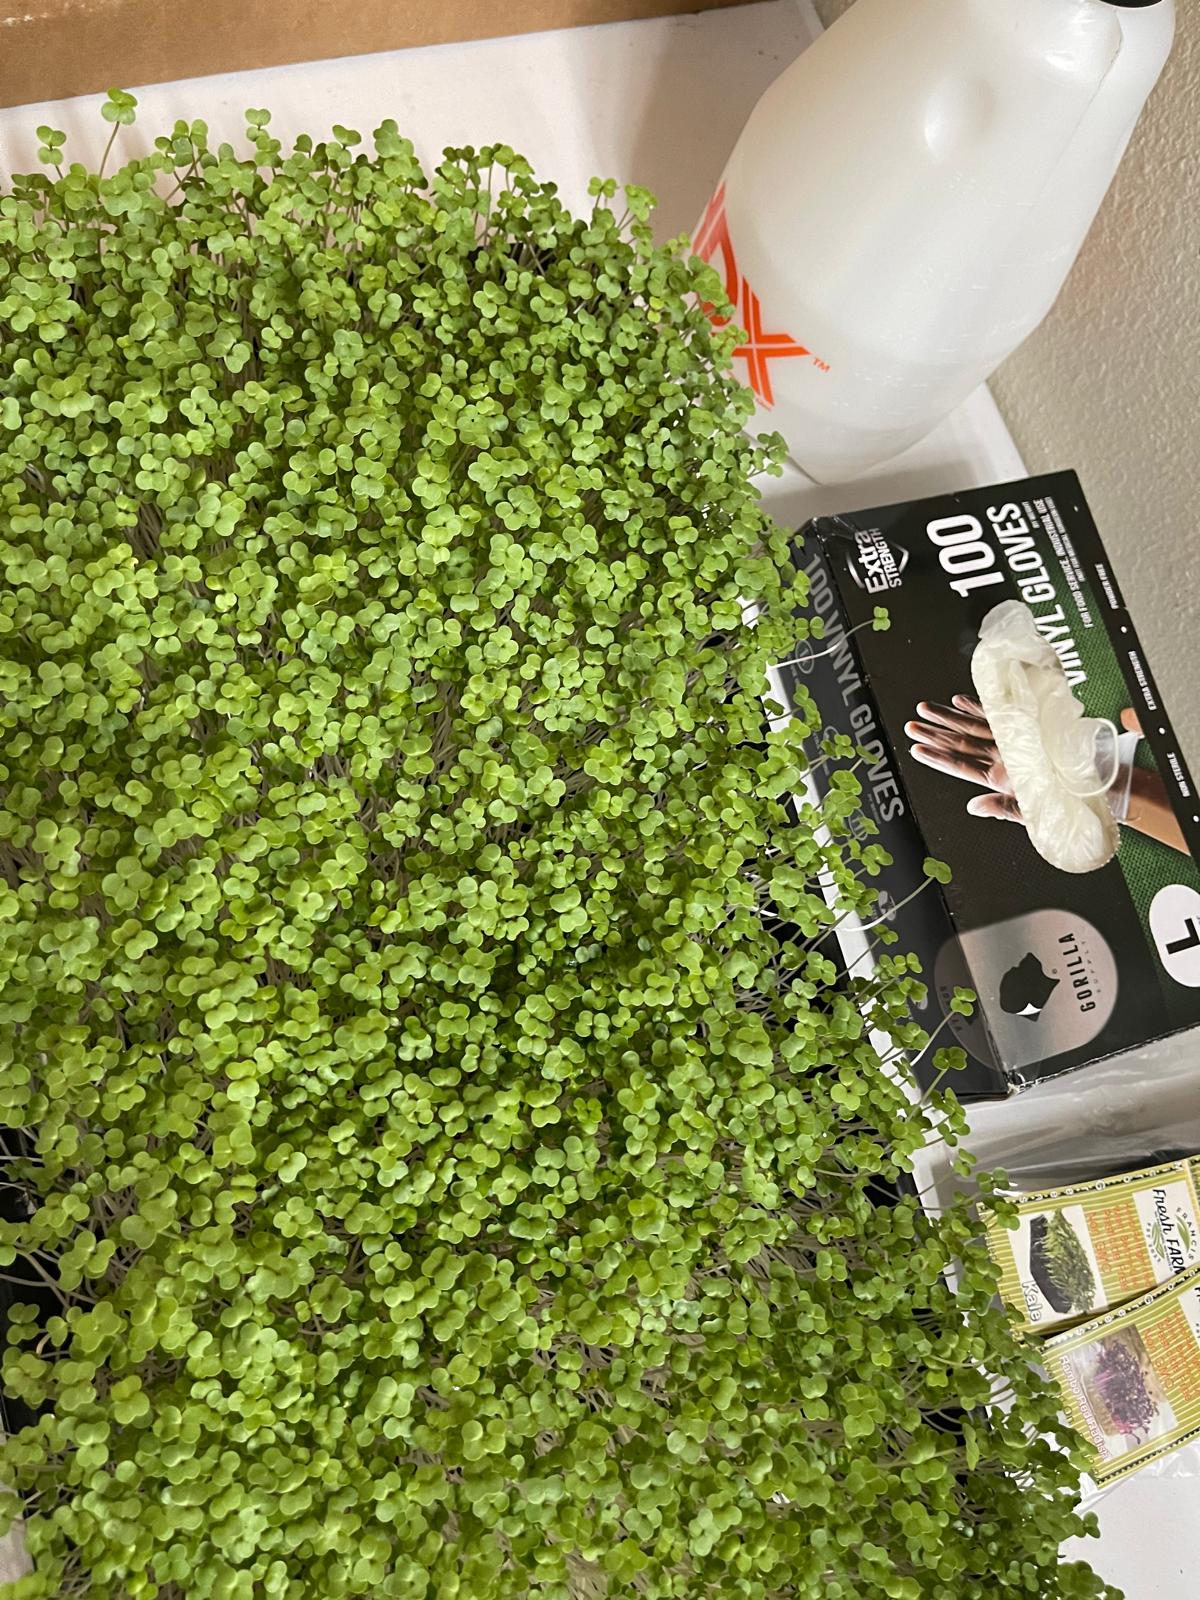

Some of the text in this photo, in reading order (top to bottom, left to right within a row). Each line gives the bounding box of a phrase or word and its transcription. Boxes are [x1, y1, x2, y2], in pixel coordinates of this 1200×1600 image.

[1033, 499, 1048, 515] USE
[855, 529, 890, 594] Extra
[869, 528, 902, 588] STRENGTH
[926, 514, 1005, 598] 100
[986, 502, 1056, 603] GLOVES
[1041, 513, 1066, 557] INDUSTRIAL
[804, 552, 905, 822] 100 VINYL GLOVES
[1128, 650, 1158, 711] EXTRA STRENGTH
[1166, 751, 1191, 797] NON STERILE
[1166, 918, 1200, 955] L
[1058, 933, 1096, 1012] GORILLA
[1152, 1188, 1175, 1236] Fresh
[1176, 1207, 1197, 1260] FRANCIS
[1022, 1280, 1043, 1322] Kale
[1059, 1354, 1081, 1395] Rambo
